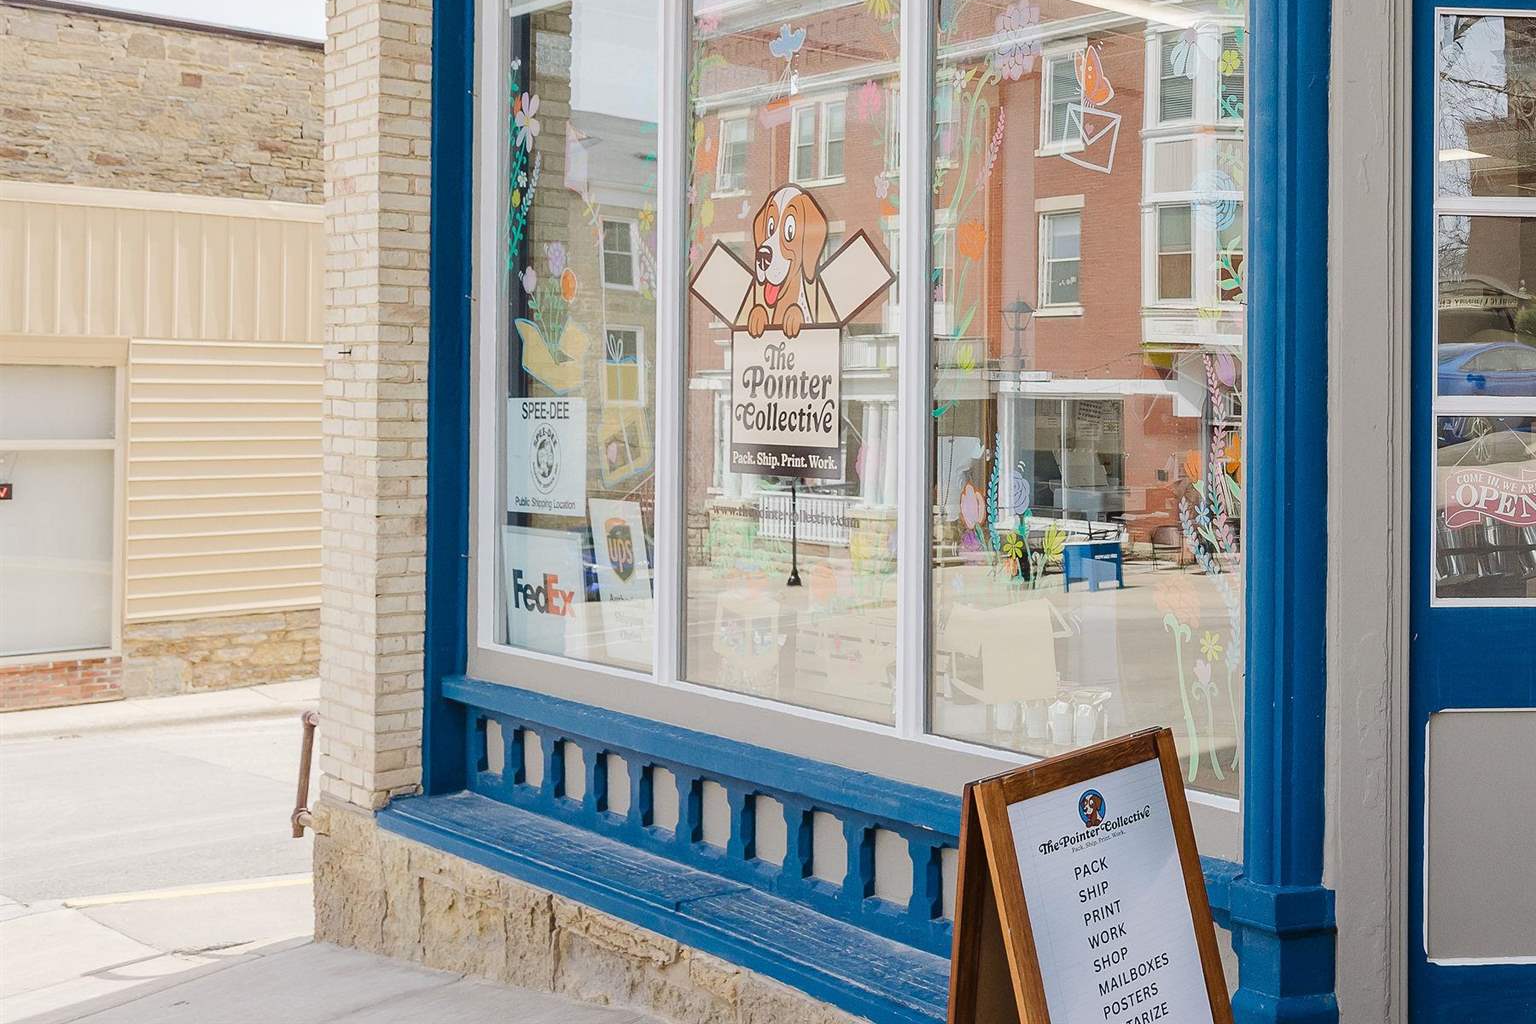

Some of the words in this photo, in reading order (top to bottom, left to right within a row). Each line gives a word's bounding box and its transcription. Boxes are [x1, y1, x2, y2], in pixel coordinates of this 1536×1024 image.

[764, 341, 795, 370] The
[742, 365, 832, 399] Pointer
[521, 401, 570, 420] SPEE-DEE
[735, 399, 835, 434] Collective
[732, 450, 756, 465] Pack.
[756, 451, 780, 469] Ship.
[781, 454, 807, 468] Print.
[808, 455, 838, 470] Work.
[1456, 473, 1484, 485] COME
[1503, 481, 1518, 492] WE
[515, 496, 530, 506] Public
[608, 537, 633, 572] ups
[512, 568, 576, 617] FedEx
[1039, 840, 1059, 855] The
[1059, 827, 1100, 848] Pointer
[1101, 805, 1151, 832] Collective
[1074, 857, 1108, 880] PACK
[1078, 881, 1109, 903] SHIP
[1083, 900, 1121, 926] PRINT
[1088, 923, 1127, 949] WORK
[1093, 947, 1128, 972] SHOP
[1099, 952, 1169, 996] MAILBOXES
[1103, 982, 1159, 1020] POSTERS
